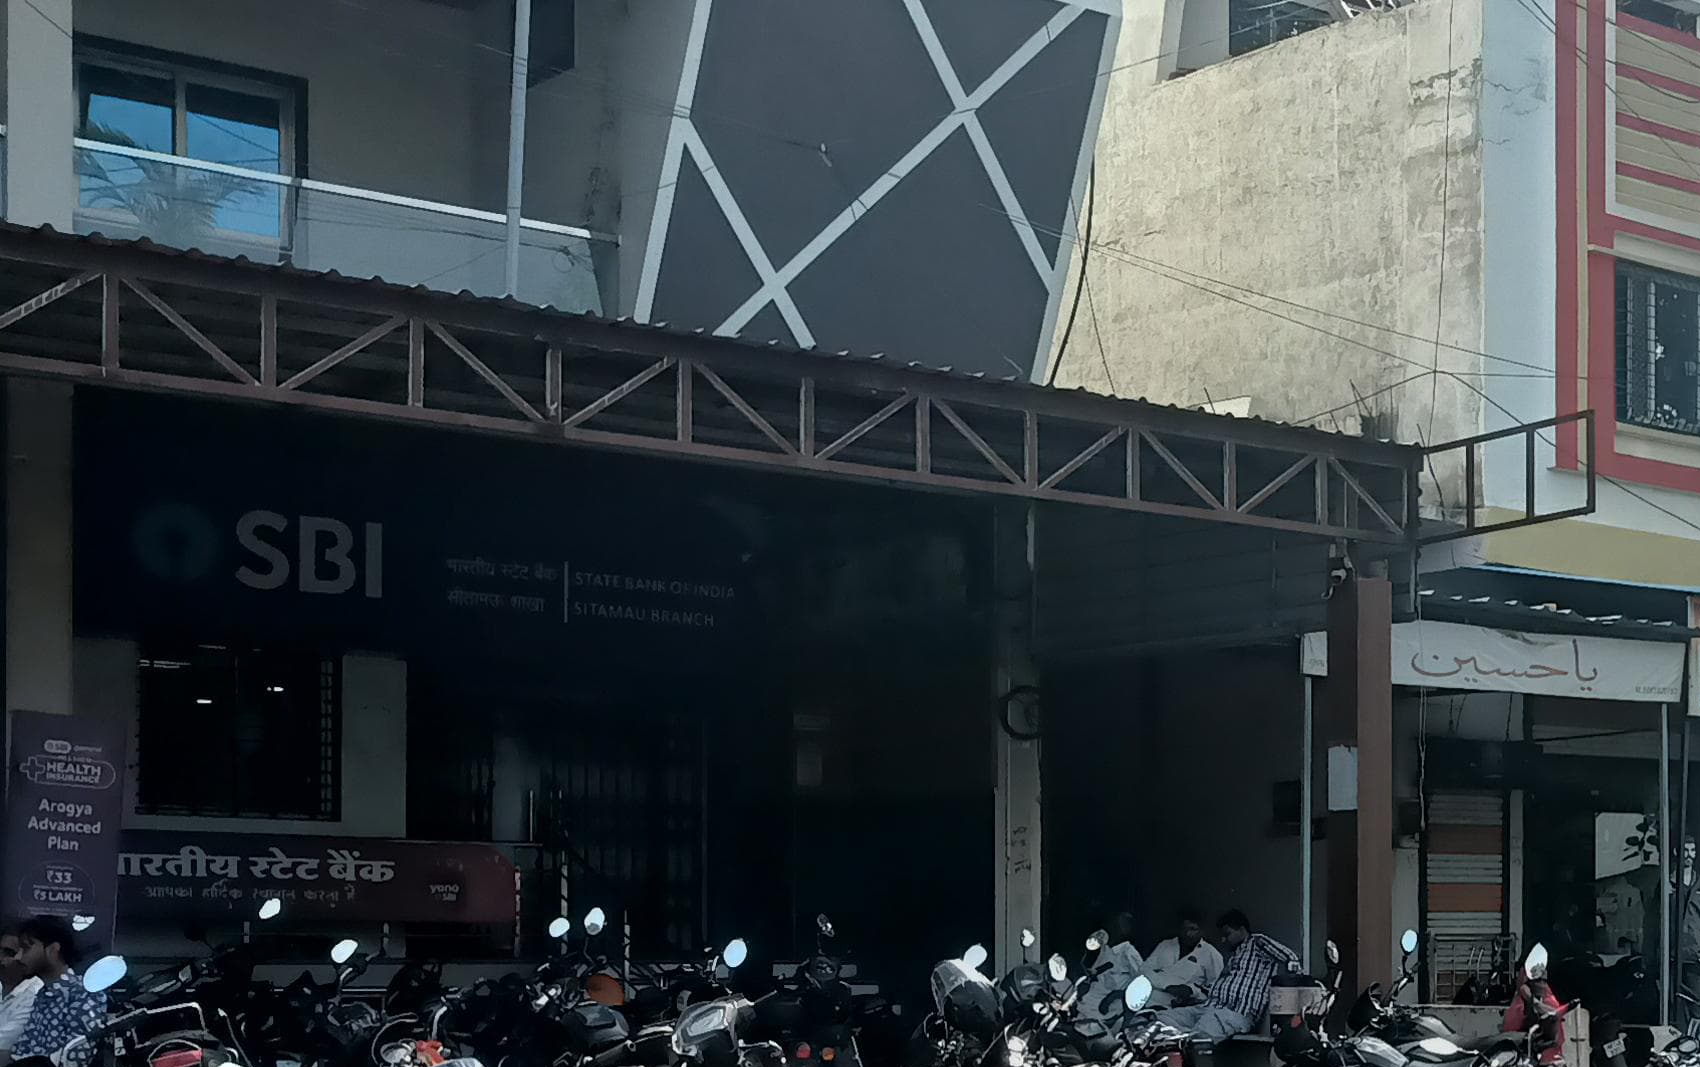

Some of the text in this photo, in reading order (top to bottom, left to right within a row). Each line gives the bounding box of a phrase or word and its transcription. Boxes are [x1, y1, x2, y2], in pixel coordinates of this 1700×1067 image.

[236, 510, 383, 598] SBI
[575, 571, 624, 588] STATE
[626, 576, 666, 592] BANK
[692, 583, 735, 600] INDIA
[575, 601, 714, 627] SITAMAU BRANCH
[47, 761, 101, 776] HEALTH
[47, 772, 100, 784] INSURANCE
[39, 798, 93, 818] Arogya
[28, 816, 101, 834] Advanced
[48, 836, 79, 851] Plan
[248, 846, 320, 881] स्टेट
[326, 848, 396, 883] बैंक
[46, 870, 72, 884] ₹33
[48, 891, 83, 903] LAKH
